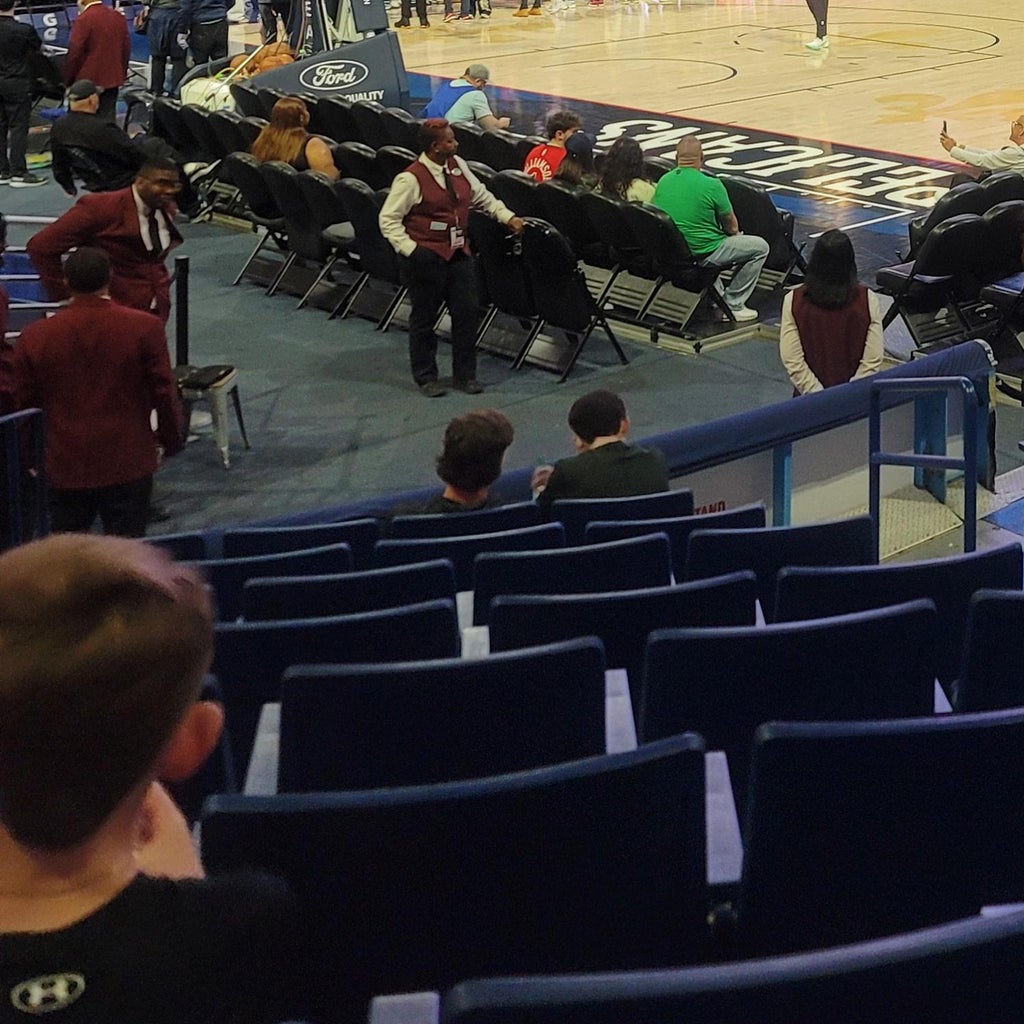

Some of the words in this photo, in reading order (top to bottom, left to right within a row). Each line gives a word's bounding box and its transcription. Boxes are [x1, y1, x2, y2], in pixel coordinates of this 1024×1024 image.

[43, 12, 58, 27] G
[312, 64, 357, 87] Ford
[344, 90, 385, 103] QUALITY
[594, 119, 956, 208] PELICANS
[694, 500, 726, 515] TAND
